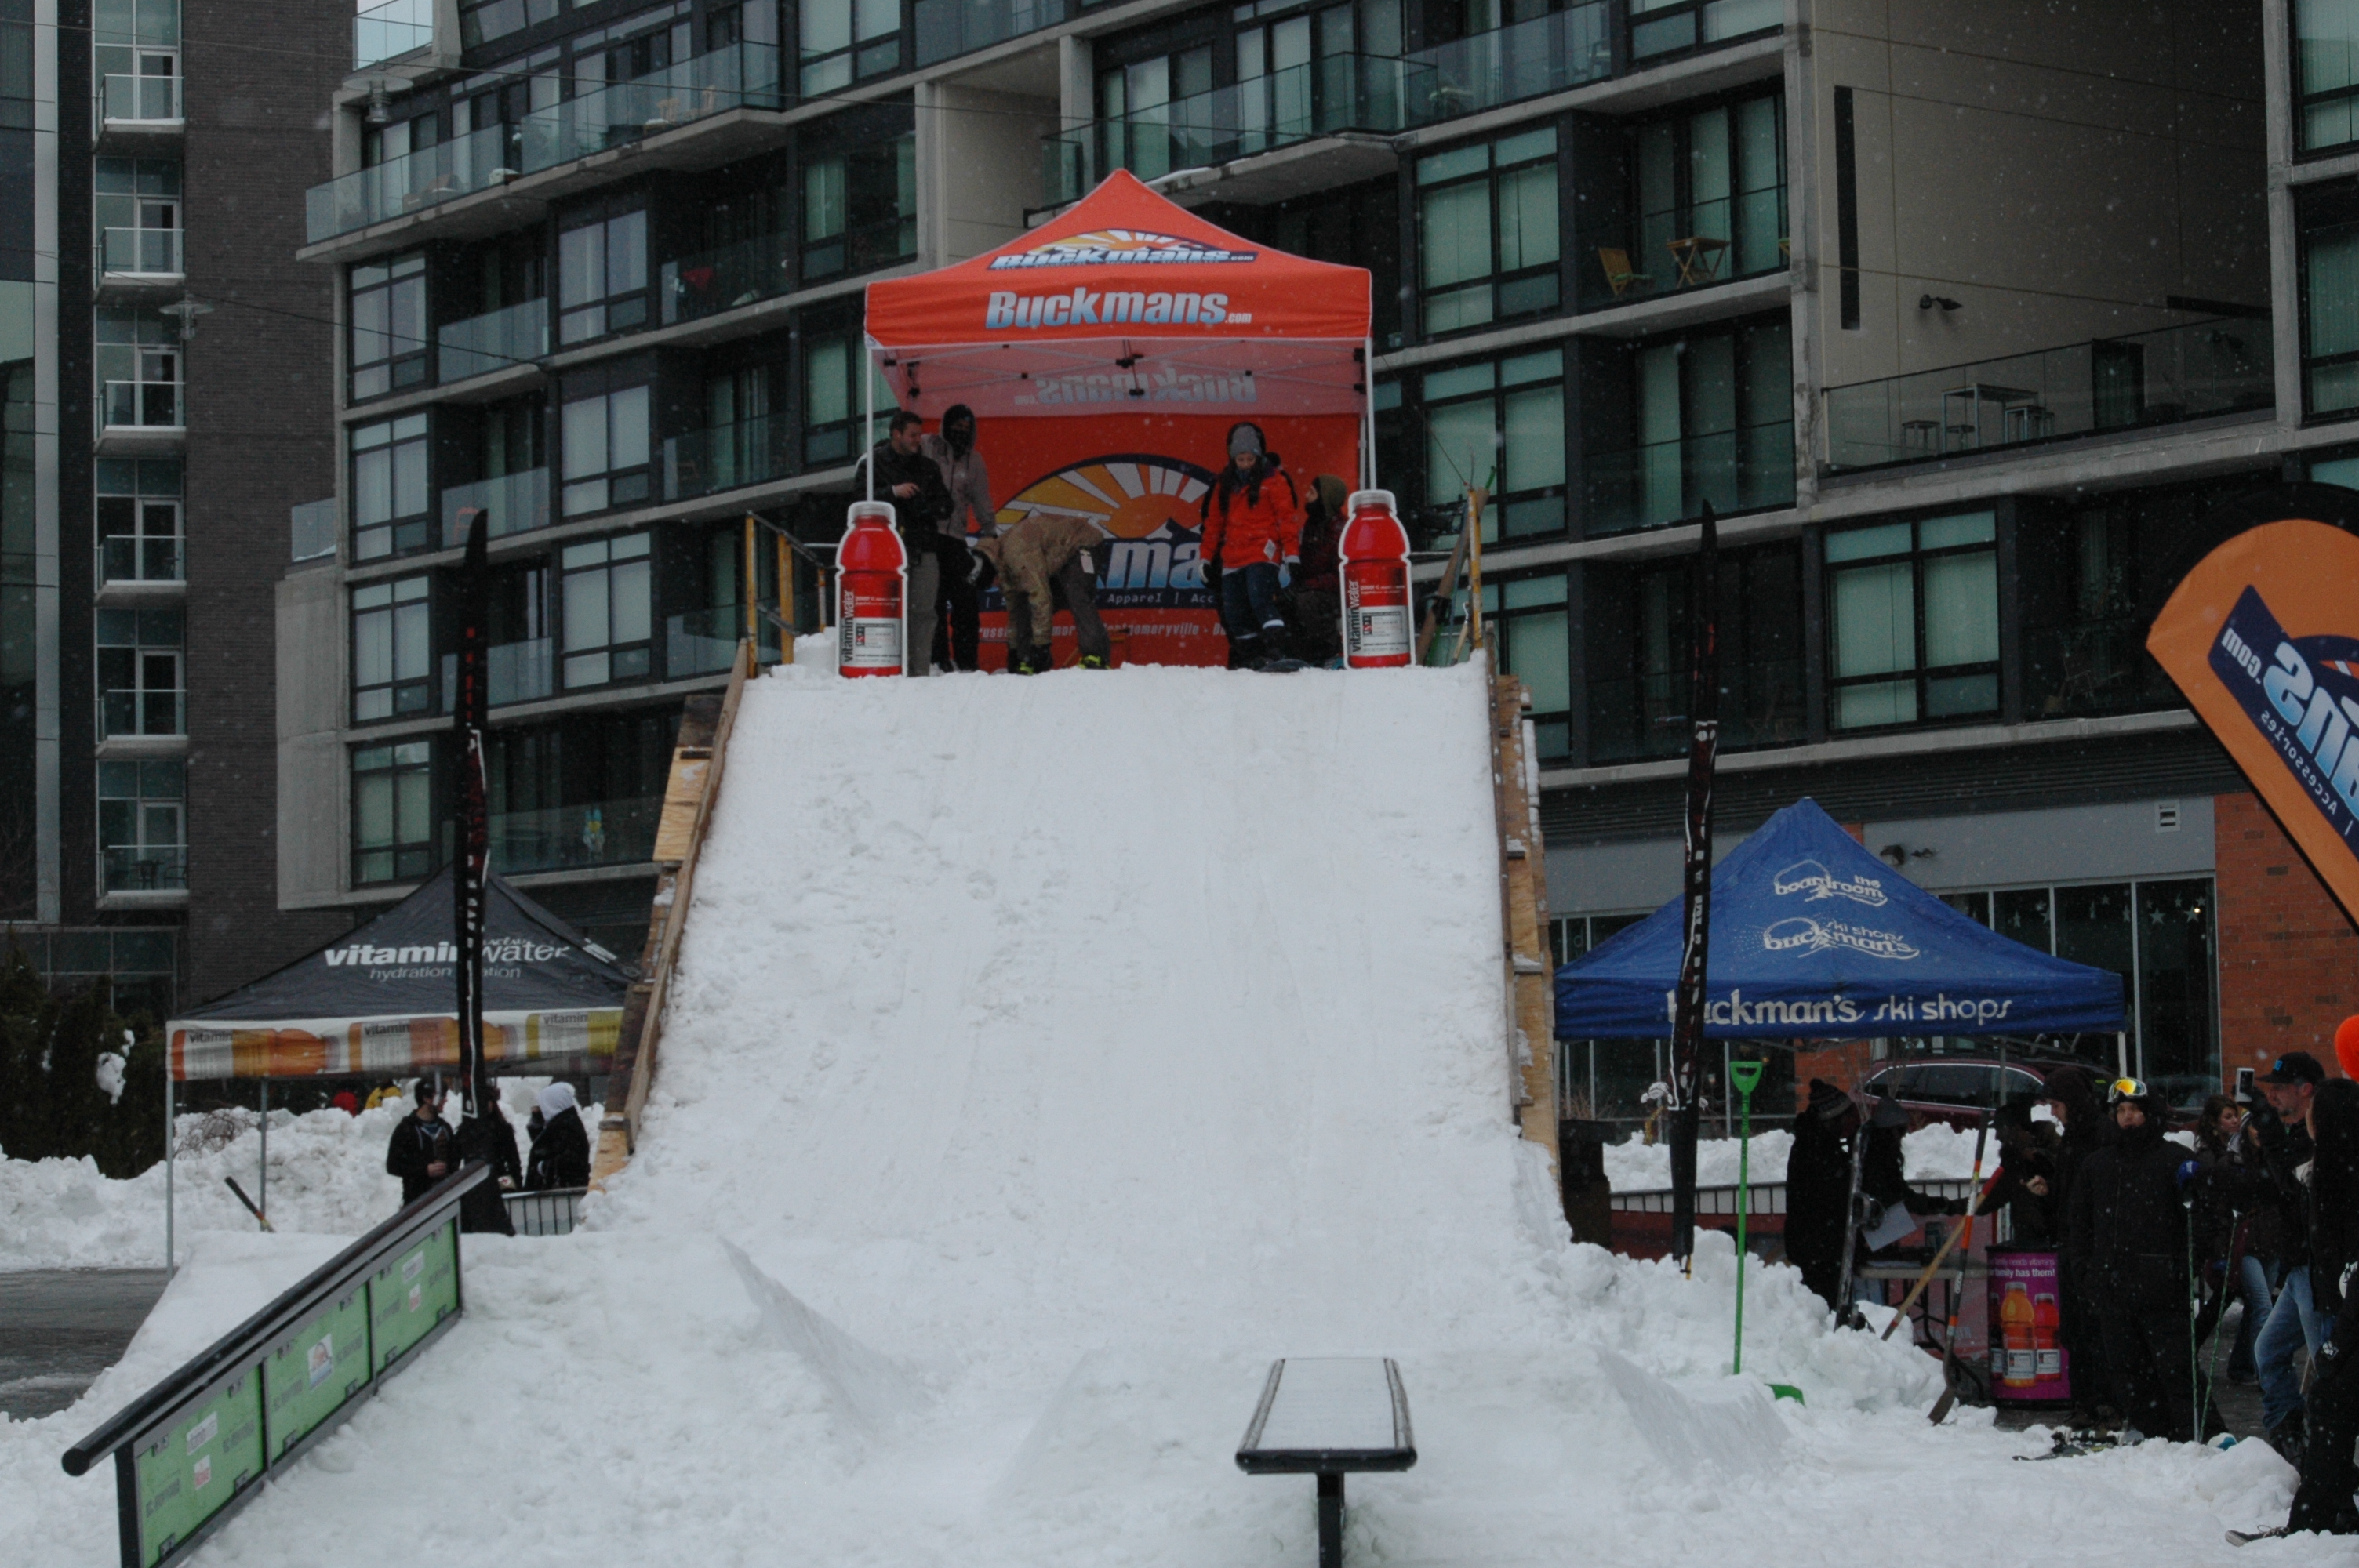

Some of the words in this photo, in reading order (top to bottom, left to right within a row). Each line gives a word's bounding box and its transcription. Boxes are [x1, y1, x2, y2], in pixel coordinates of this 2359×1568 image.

[985, 287, 1252, 328] Buckmans.com
[1107, 593, 1161, 604] Apparel
[1774, 874, 1884, 898] boardroom
[1854, 875, 1881, 888] the
[1826, 920, 1848, 932] ski
[1852, 926, 1904, 942] shops
[369, 965, 453, 982] hydration
[1873, 994, 1914, 1021] ski
[1921, 993, 2013, 1026] shops
[2015, 1268, 2030, 1276] has
[2031, 1268, 2055, 1276] them!
